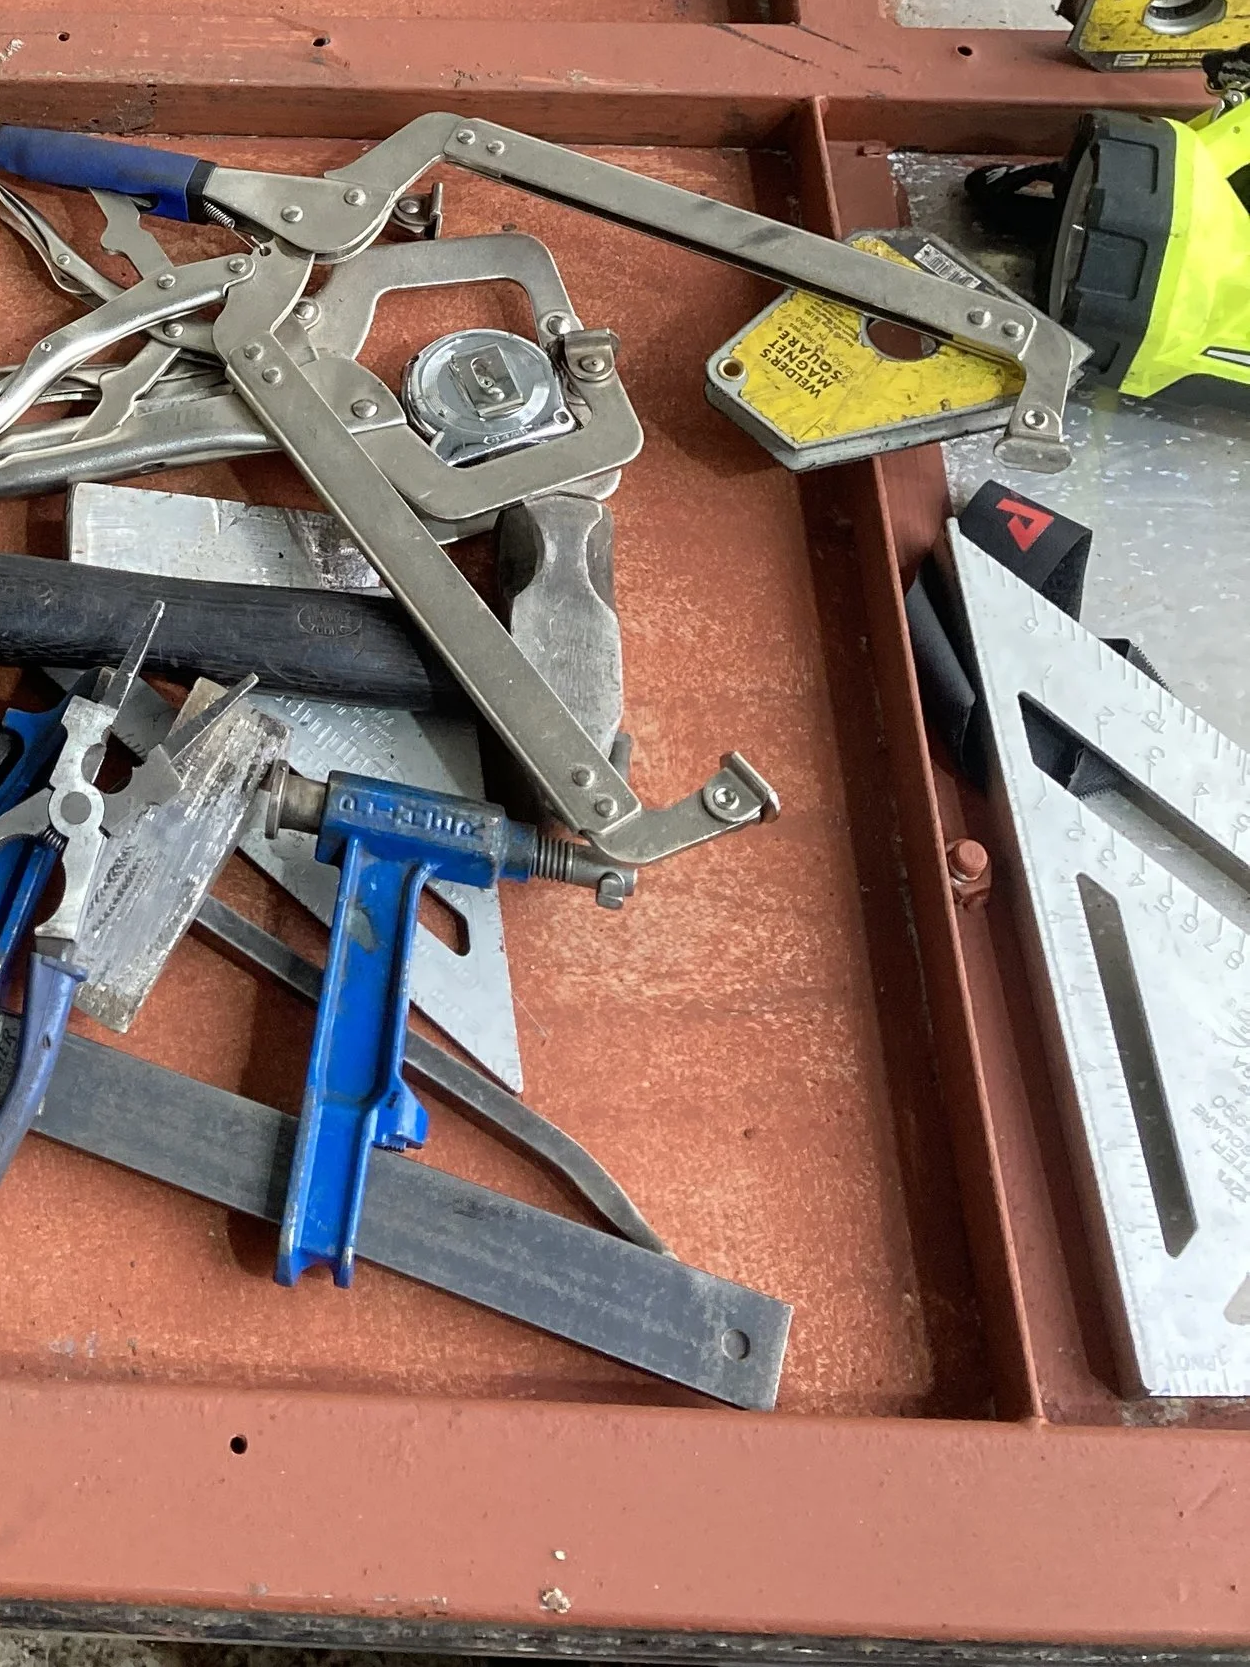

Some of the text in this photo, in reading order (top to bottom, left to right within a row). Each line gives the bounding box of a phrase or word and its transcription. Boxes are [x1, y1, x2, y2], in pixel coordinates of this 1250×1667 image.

[759, 347, 822, 399] WELDER'S
[768, 339, 833, 389] MAGNET
[778, 330, 842, 382] SQUARE
